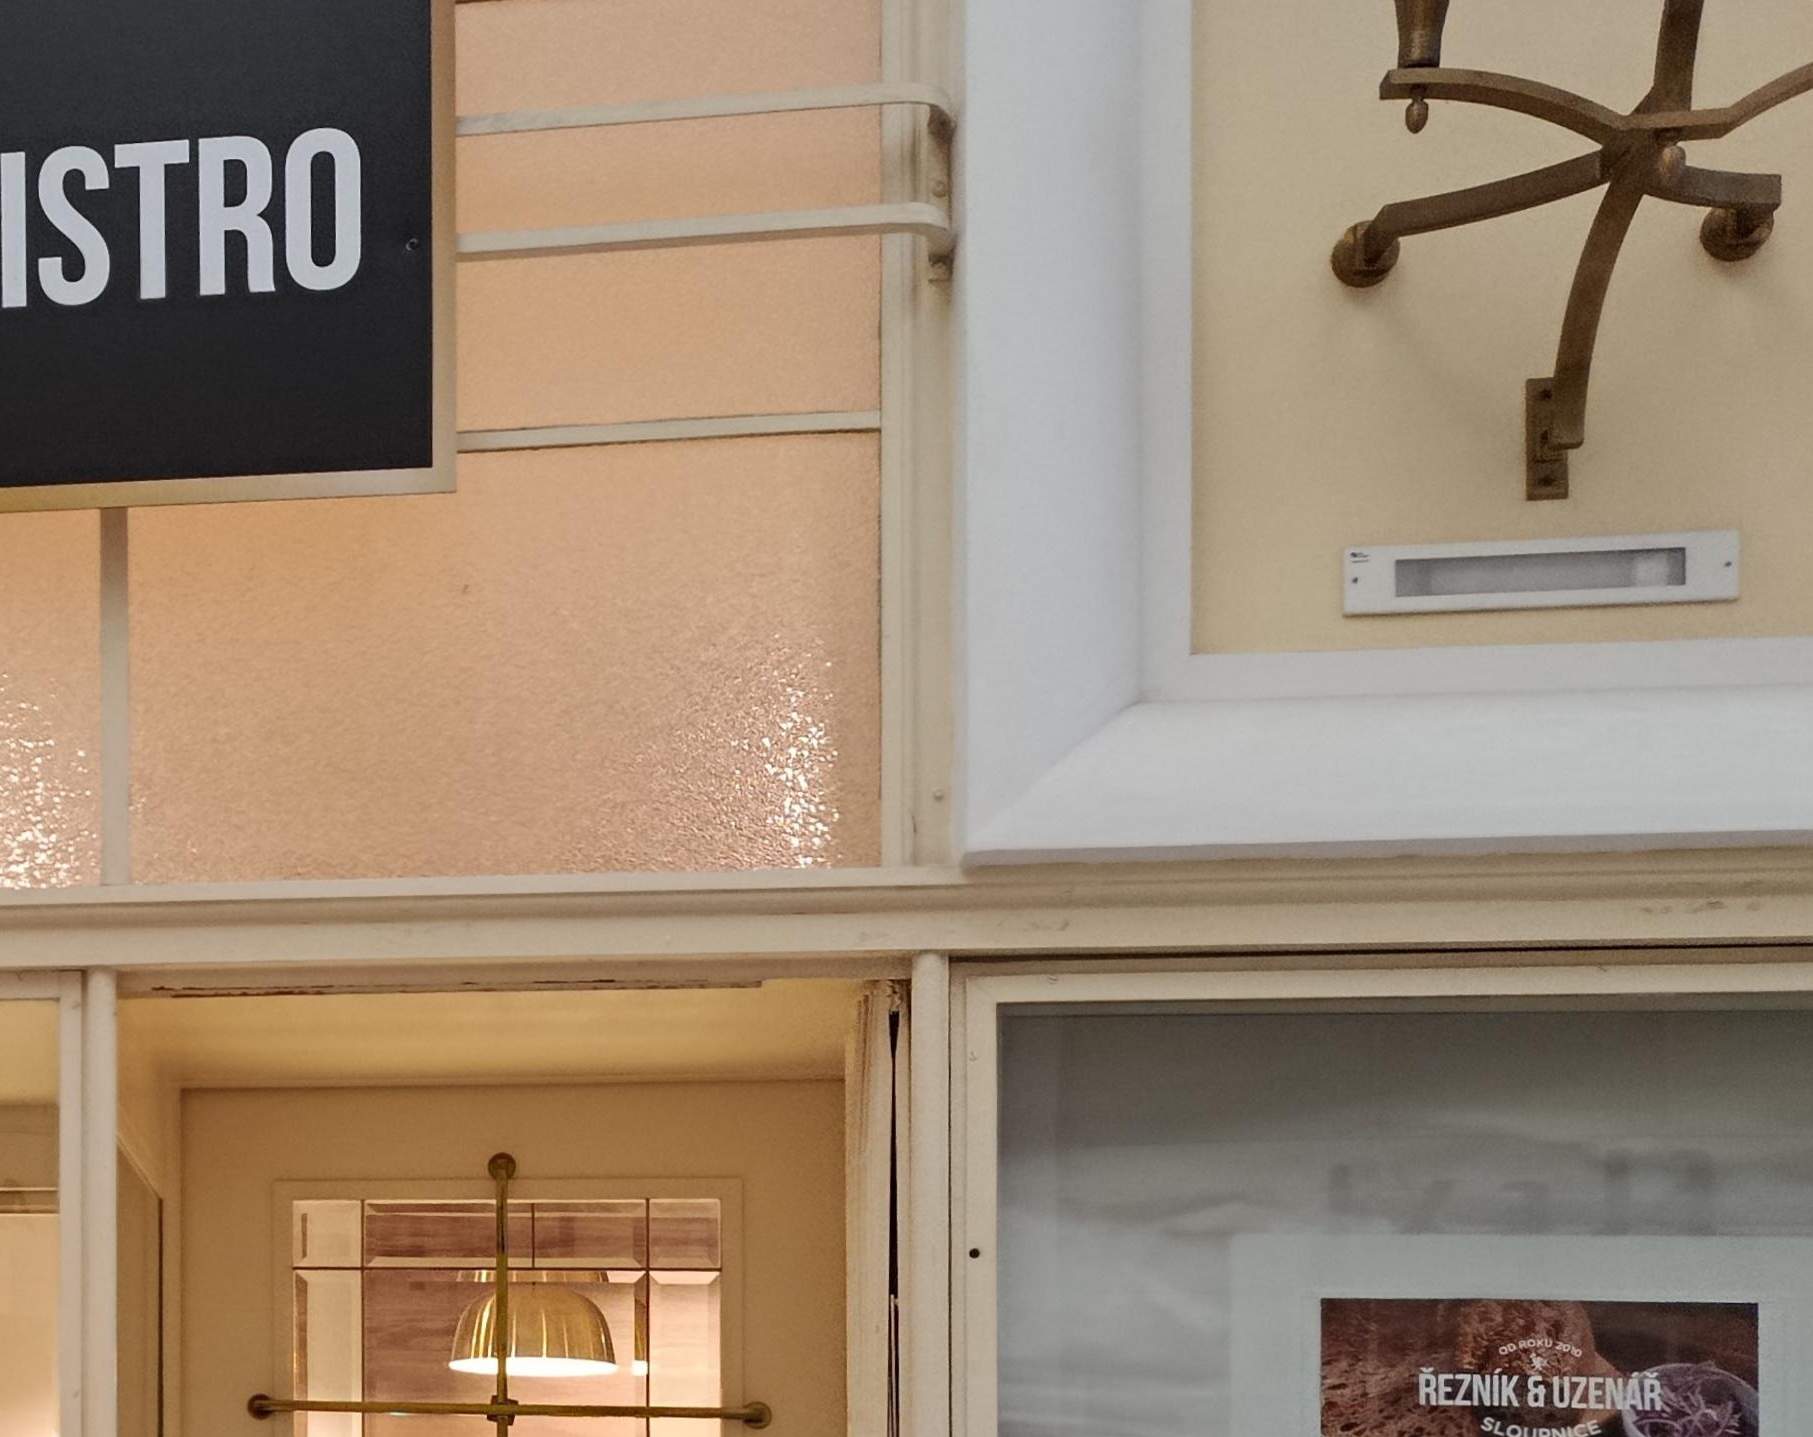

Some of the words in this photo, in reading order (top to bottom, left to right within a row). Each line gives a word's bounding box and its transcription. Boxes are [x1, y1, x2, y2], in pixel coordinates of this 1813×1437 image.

[1498, 1342, 1517, 1356] OD
[1518, 1337, 1554, 1349] ROKU
[1555, 1341, 1583, 1358] 2010
[1418, 1366, 1520, 1407] ŘEZNÍK
[1527, 1375, 1546, 1408] &
[1552, 1371, 1663, 1411] UZENÁŘ
